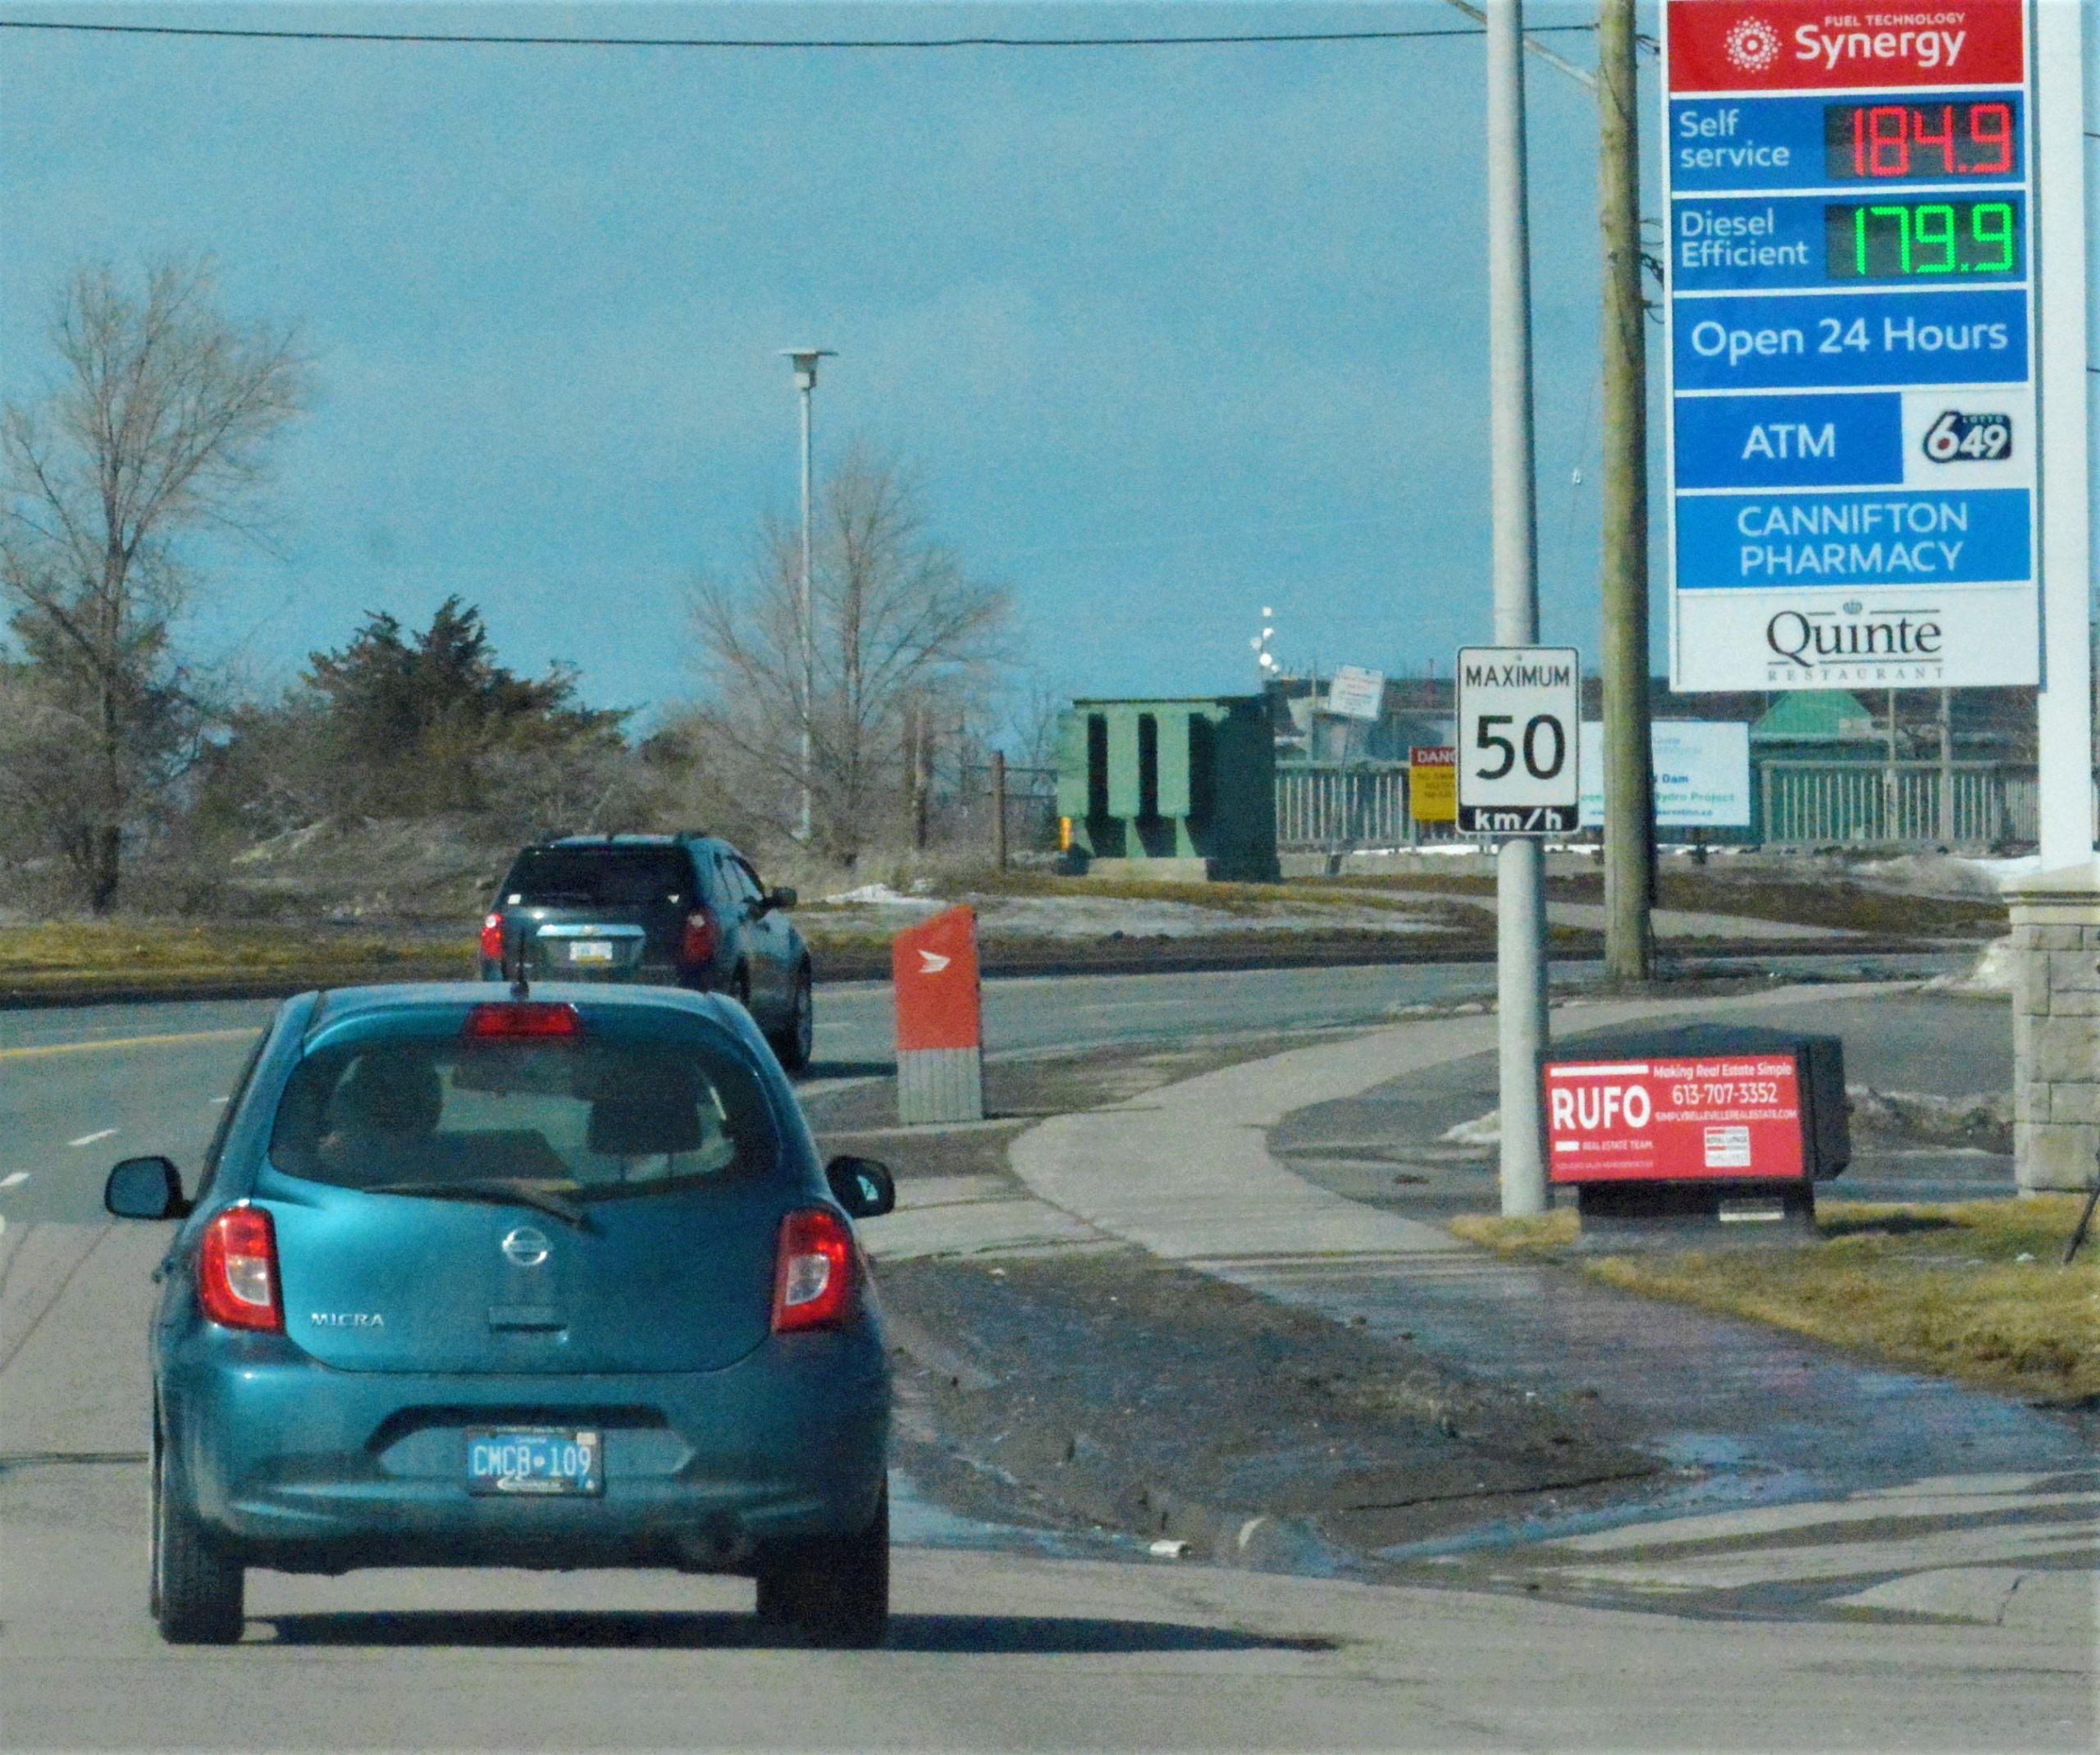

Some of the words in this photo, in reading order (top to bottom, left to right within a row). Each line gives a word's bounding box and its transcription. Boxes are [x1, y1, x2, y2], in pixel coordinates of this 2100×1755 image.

[1825, 16, 1860, 27] FUEL
[1865, 13, 1965, 26] TECHNOLOGY
[1795, 24, 1966, 70] Synergy
[1680, 109, 1740, 137] Self
[1854, 103, 2011, 176] 184.9
[1681, 142, 1790, 167] service
[1681, 208, 1774, 237] Diesel
[1681, 240, 1810, 268] Efficient
[1855, 203, 2012, 276] 179.9
[1691, 321, 1804, 367] Open
[1818, 318, 1870, 353] 24
[1883, 317, 2008, 351] Hours
[1742, 423, 1835, 459] ATM
[1737, 502, 1968, 537] CANNIFTON
[1740, 541, 1964, 576] PHARMACY
[1766, 610, 1942, 667] Quinte
[1466, 665, 1570, 688] MAXIMUM
[1768, 666, 1944, 682] RESTAURANT
[1417, 749, 1456, 763] DANG
[1476, 714, 1566, 780] 50
[1475, 808, 1562, 831] km/h
[1653, 1065, 1693, 1080] Making
[1696, 1064, 1719, 1076] Real
[1722, 1064, 1755, 1076] Estate
[1757, 1062, 1792, 1077] Simple
[1551, 1085, 1651, 1130] RUFO
[1672, 1082, 1778, 1105] 613-707-3352
[311, 1313, 385, 1327] MICRA
[550, 1446, 591, 1476] 109
